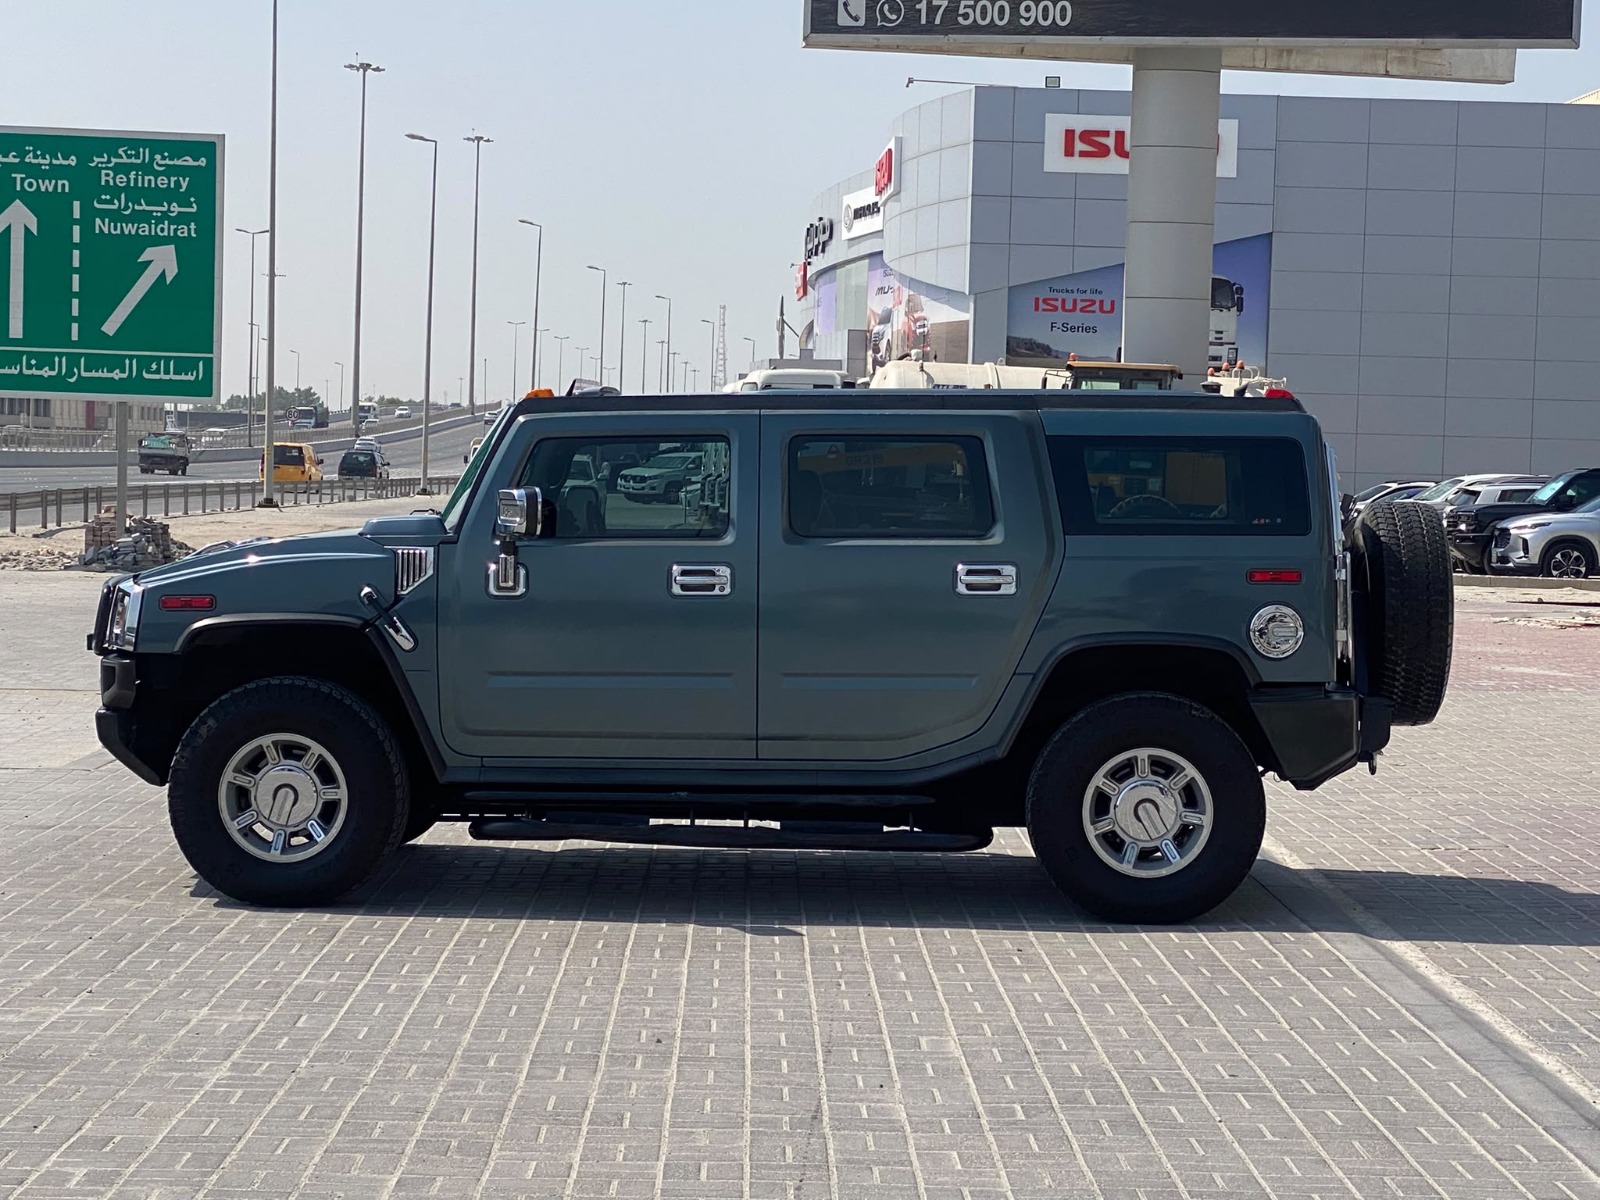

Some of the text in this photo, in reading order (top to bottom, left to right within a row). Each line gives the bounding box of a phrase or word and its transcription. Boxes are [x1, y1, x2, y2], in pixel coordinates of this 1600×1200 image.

[915, 0, 1072, 26] 17 500 900
[24, 146, 77, 170] مدينة
[88, 146, 207, 170] مصنع التكرير
[11, 173, 70, 193] Town
[100, 169, 190, 192] Refinery
[93, 192, 198, 216] نويدرات
[94, 217, 197, 238] Nuwaidrat
[1048, 286, 1075, 294] Trucks
[1089, 287, 1103, 295] life
[1033, 296, 1116, 315] ISUZU
[1050, 321, 1098, 334] F-Series
[0, 354, 204, 383] اسلك المسار المناس
[287, 410, 299, 419] 80
